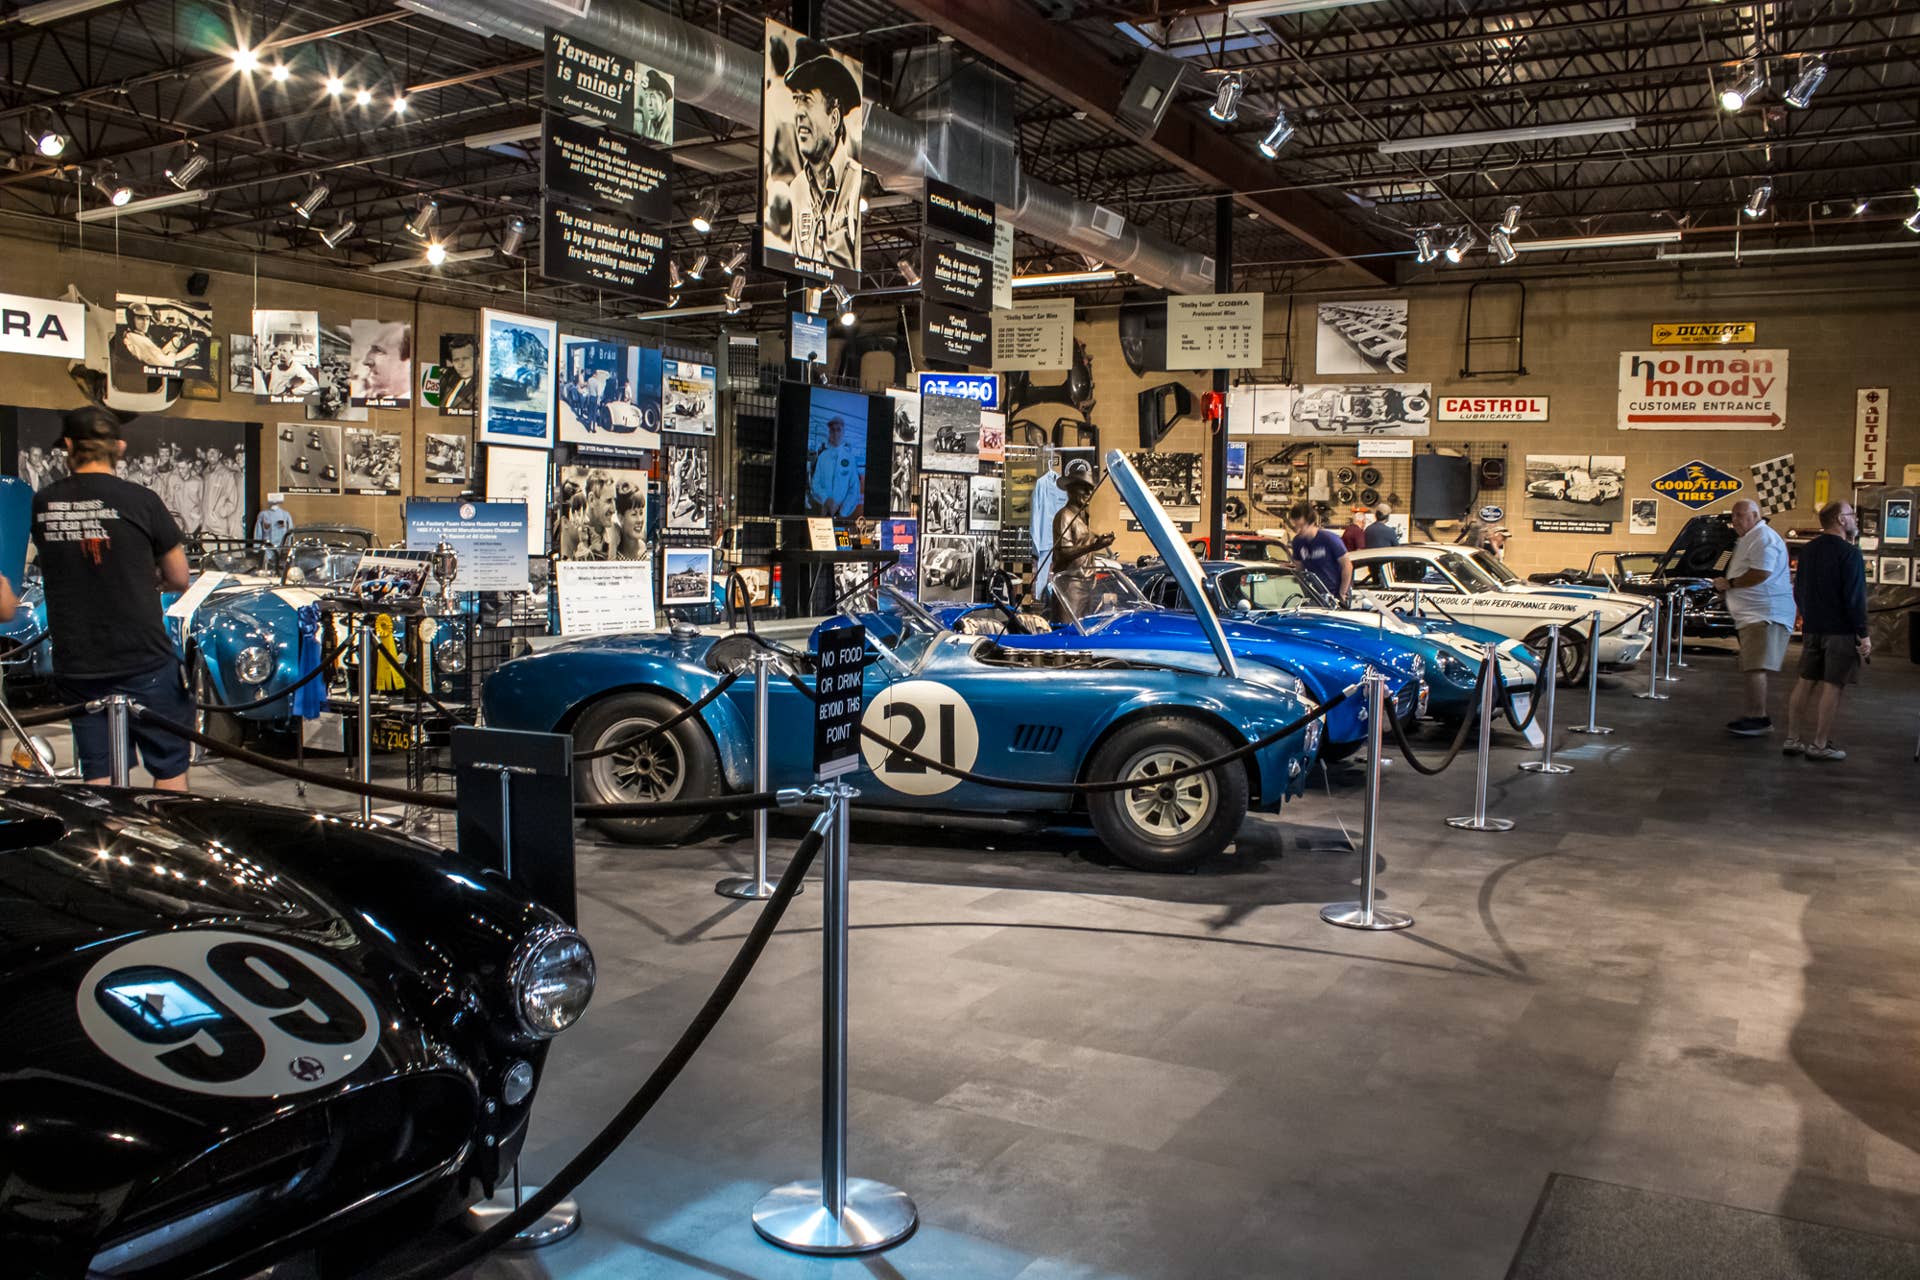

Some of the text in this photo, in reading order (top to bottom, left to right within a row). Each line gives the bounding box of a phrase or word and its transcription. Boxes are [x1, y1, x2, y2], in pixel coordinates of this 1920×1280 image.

[557, 60, 572, 80] is
[624, 68, 650, 88] ass
[930, 194, 993, 225] COBRA Daytona Coupe
[563, 228, 571, 241] is
[572, 230, 582, 246] by
[582, 235, 597, 250] any
[630, 246, 636, 257] a
[574, 217, 592, 230] race
[592, 222, 619, 237] version
[619, 228, 628, 240] of
[628, 229, 640, 242] the
[641, 233, 663, 249] COBRA
[567, 245, 619, 270] fire-breathing
[795, 257, 834, 280] Carroll Shelby
[1676, 325, 1746, 336] DUNLOP
[1630, 355, 1773, 379] holman
[1645, 375, 1776, 398] moody
[1446, 399, 1541, 413] CASTROL
[1629, 401, 1771, 411] CUSTOMER ENTRANCE
[1863, 407, 1879, 480] AUTOLITE
[1677, 491, 1715, 501] TIRES
[1433, 596, 1459, 606] SCHOOL
[1460, 597, 1471, 606] OF
[1491, 599, 1547, 611] PERFORMANCE
[821, 646, 863, 667] NO FOOD
[820, 672, 862, 694] OR DRINK
[819, 696, 861, 721] BEYOND THIS
[826, 724, 852, 745] POINT
[883, 702, 956, 775] 21
[94, 941, 368, 1084] 99
